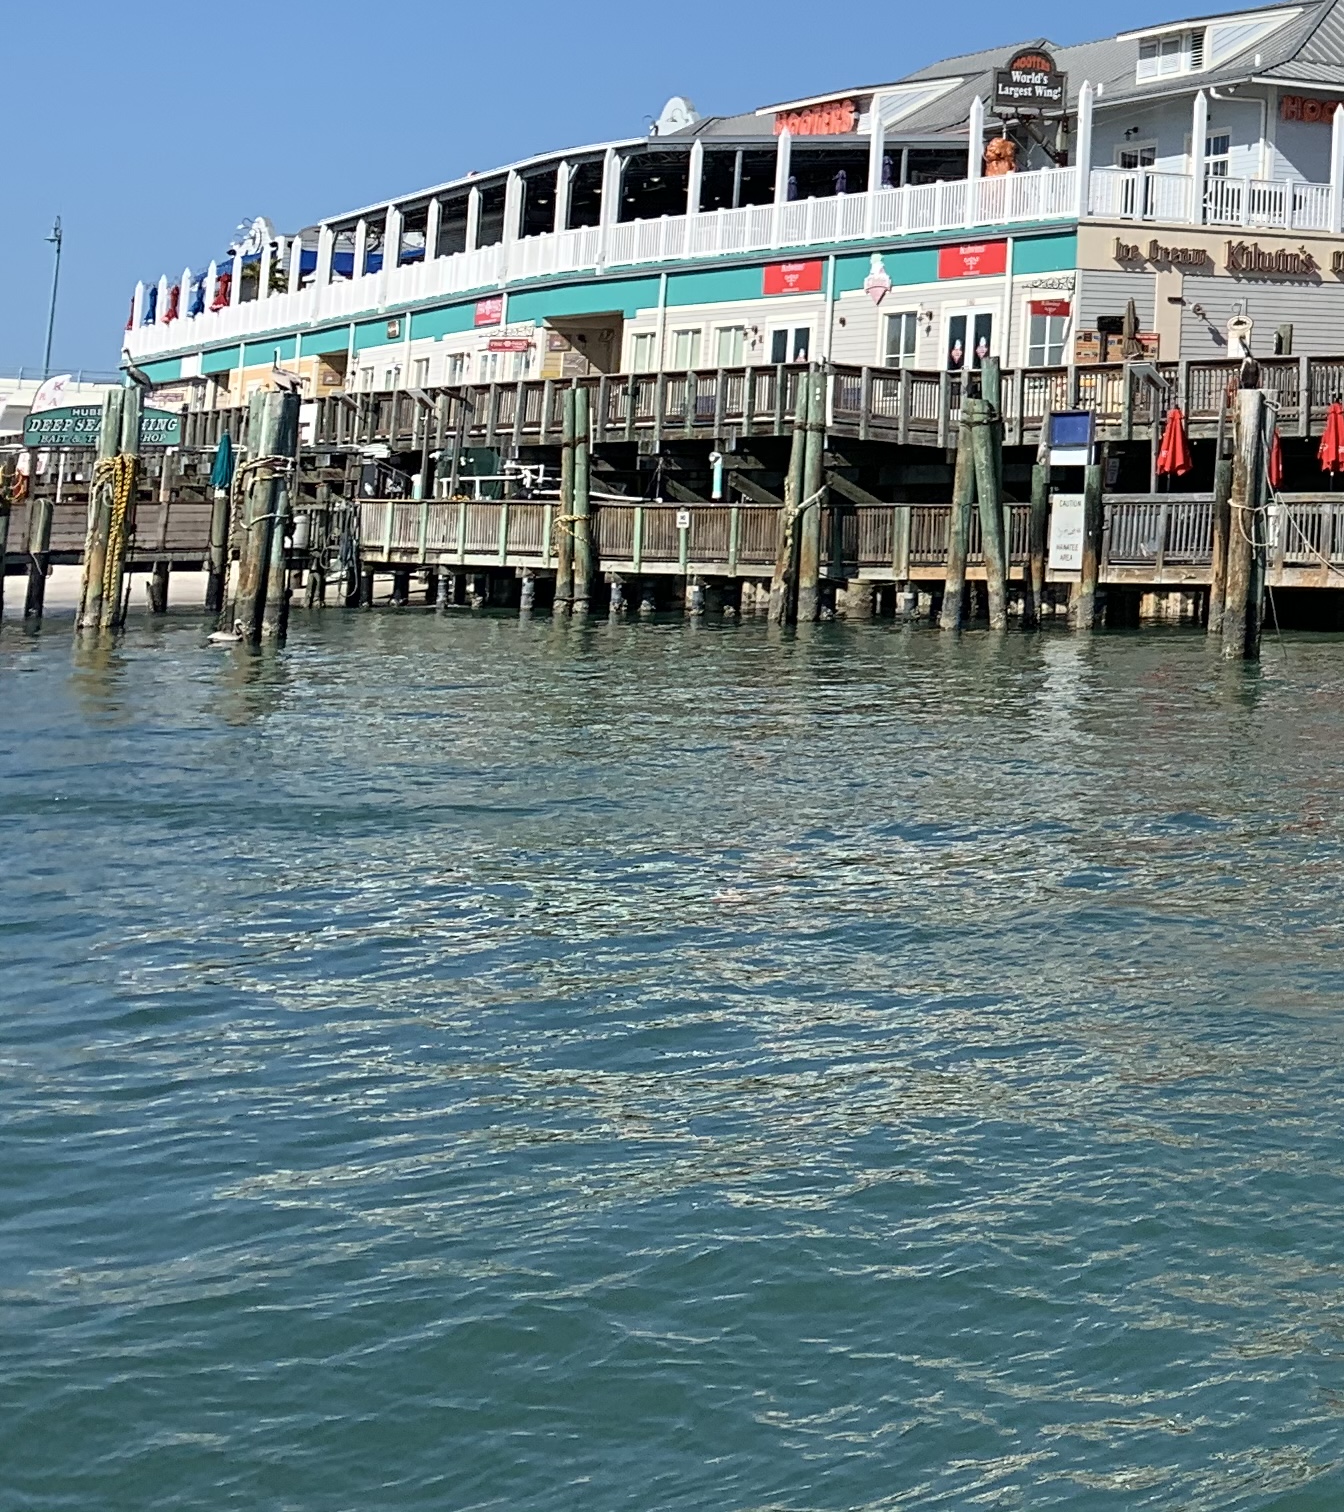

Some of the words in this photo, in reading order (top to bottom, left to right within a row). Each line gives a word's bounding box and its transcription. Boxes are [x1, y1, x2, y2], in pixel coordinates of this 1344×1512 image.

[1013, 55, 1051, 72] HOOTERS
[1011, 71, 1049, 84] World's
[998, 83, 1033, 99] Largest
[1035, 85, 1062, 100] Wing!
[1113, 236, 1139, 261] Ice
[1149, 239, 1208, 266] Cream
[1225, 240, 1316, 274] Kilwin's
[28, 418, 73, 432] DEEP
[39, 434, 67, 443] BAIT
[71, 435, 81, 443] &
[141, 433, 167, 442] HOP
